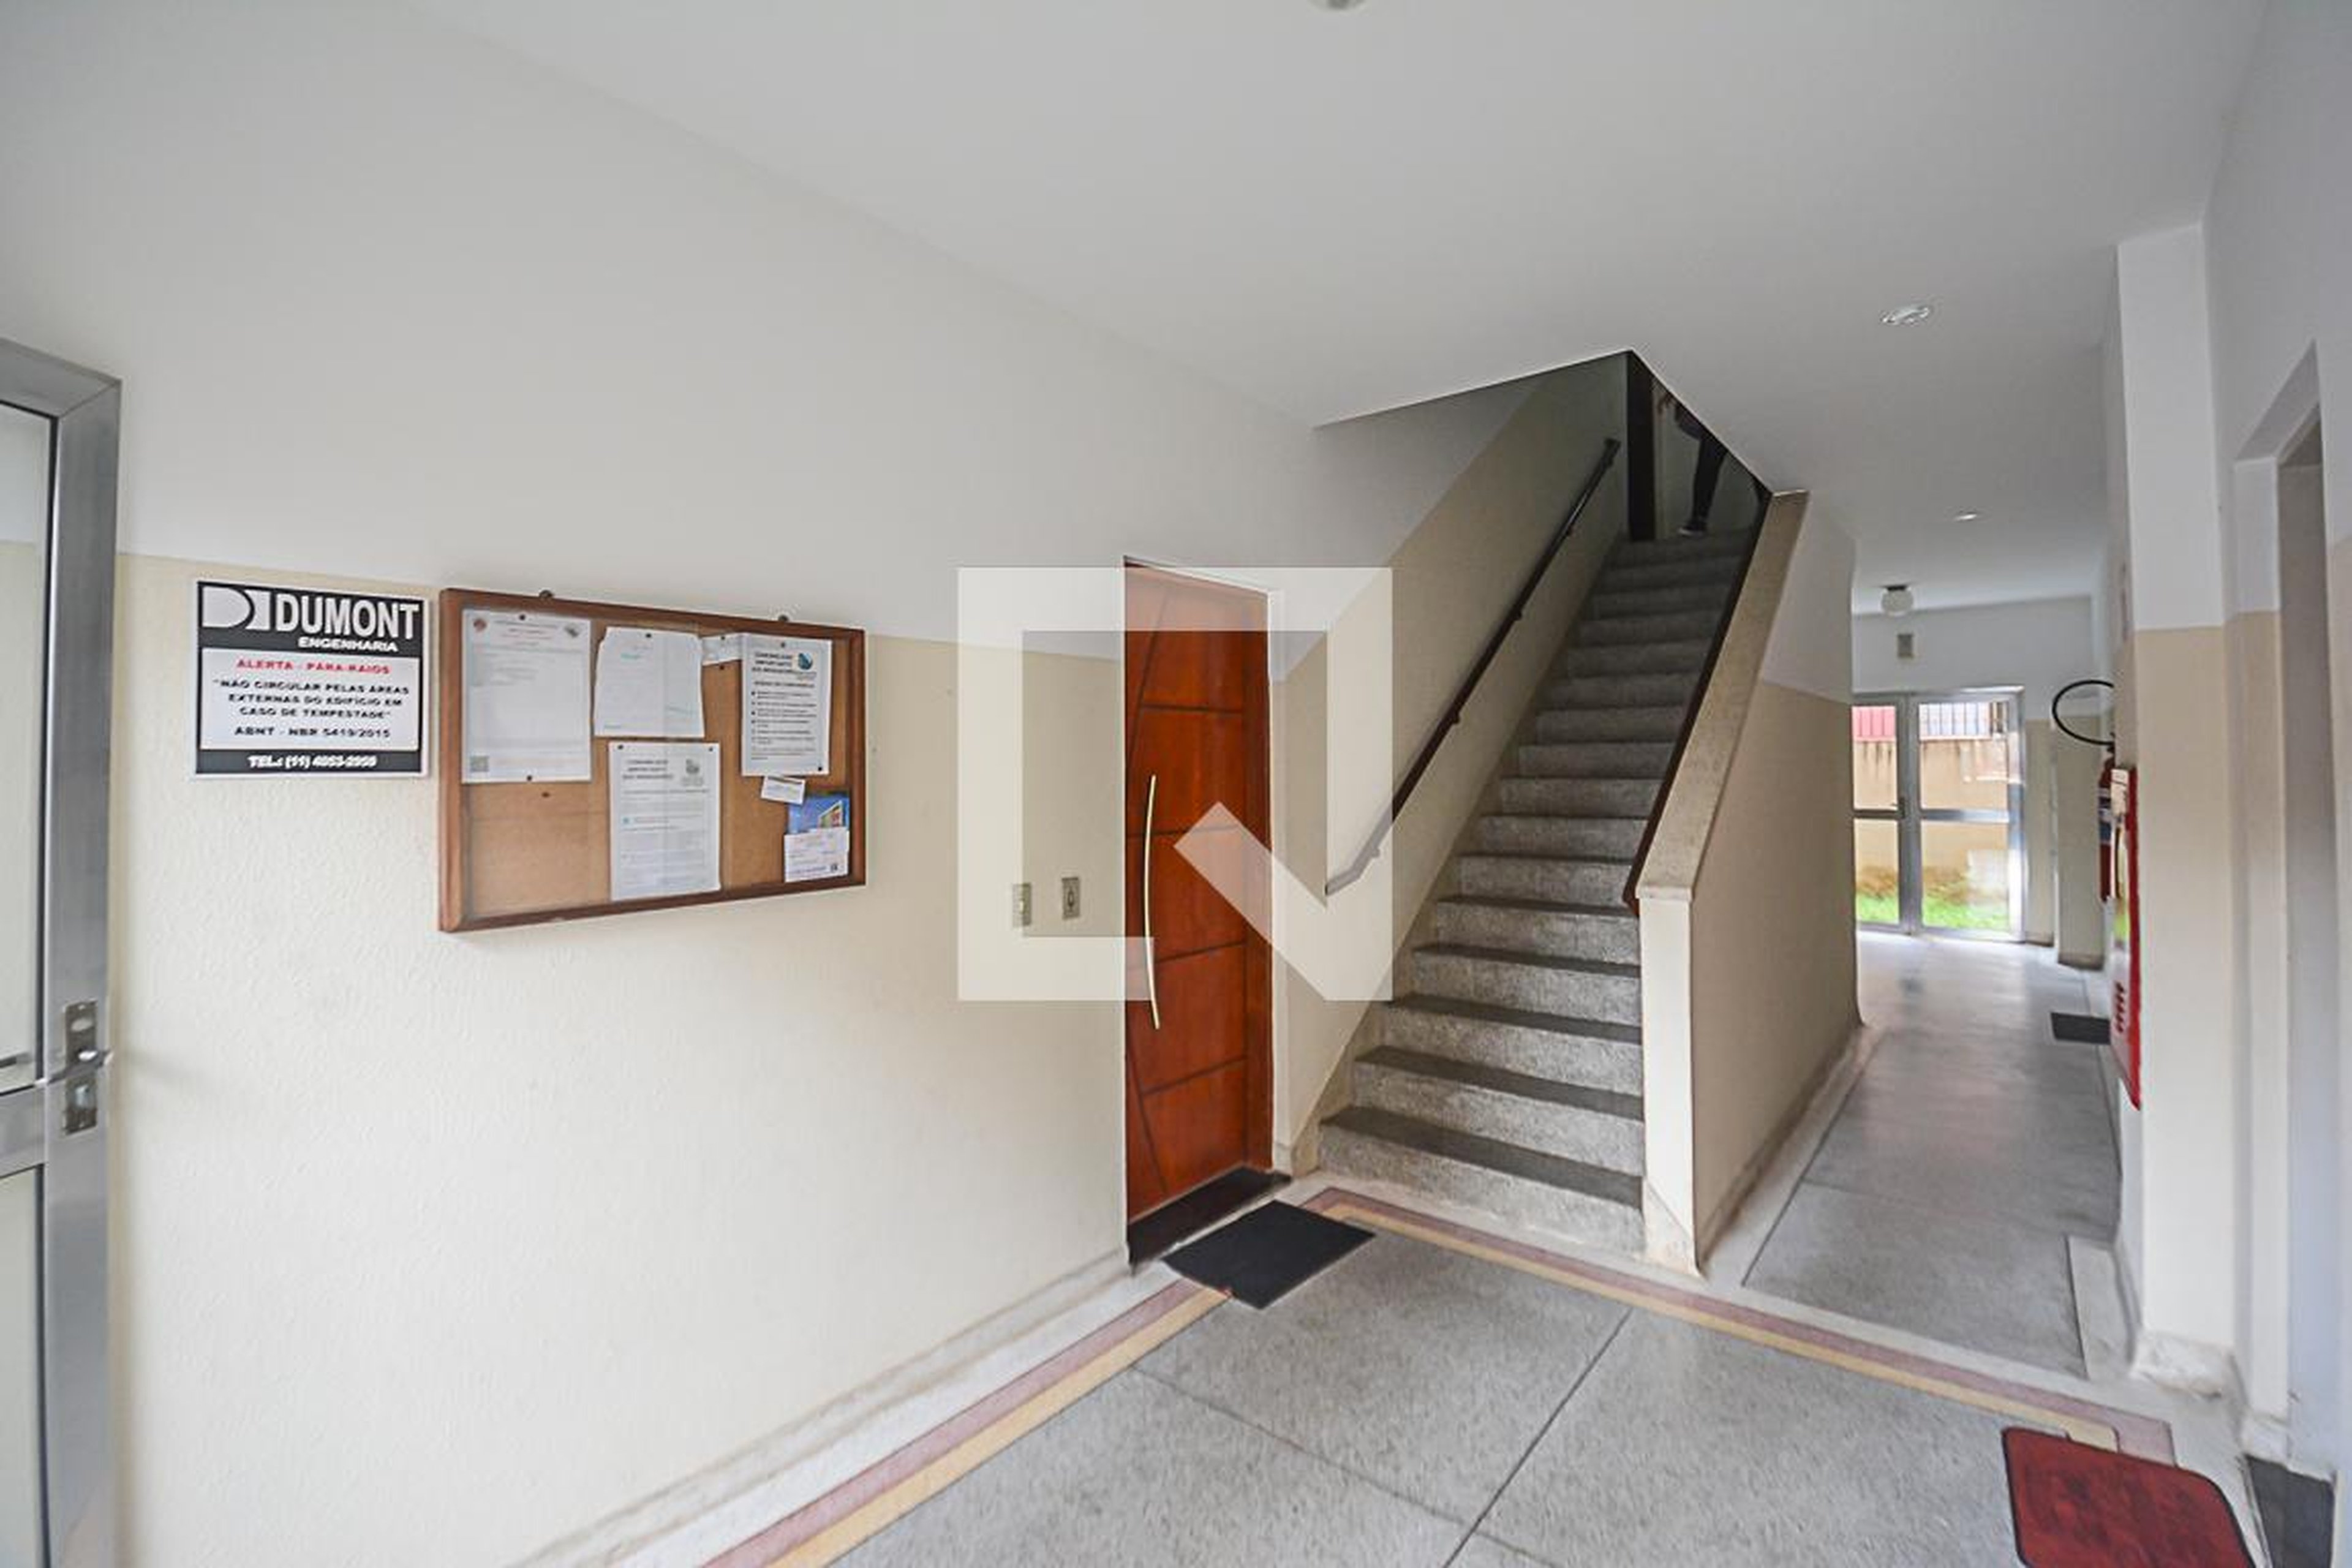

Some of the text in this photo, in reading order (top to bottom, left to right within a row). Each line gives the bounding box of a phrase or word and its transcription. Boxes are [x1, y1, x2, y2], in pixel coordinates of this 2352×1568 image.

[276, 593, 420, 640] DUMONT
[298, 636, 398, 652] ENGENHARIA
[237, 659, 294, 669] ALERTA
[254, 680, 320, 691] CIRCULAR
[325, 684, 364, 693] PELAS
[228, 694, 300, 703] EXTERNAS
[235, 726, 274, 735] ABNT
